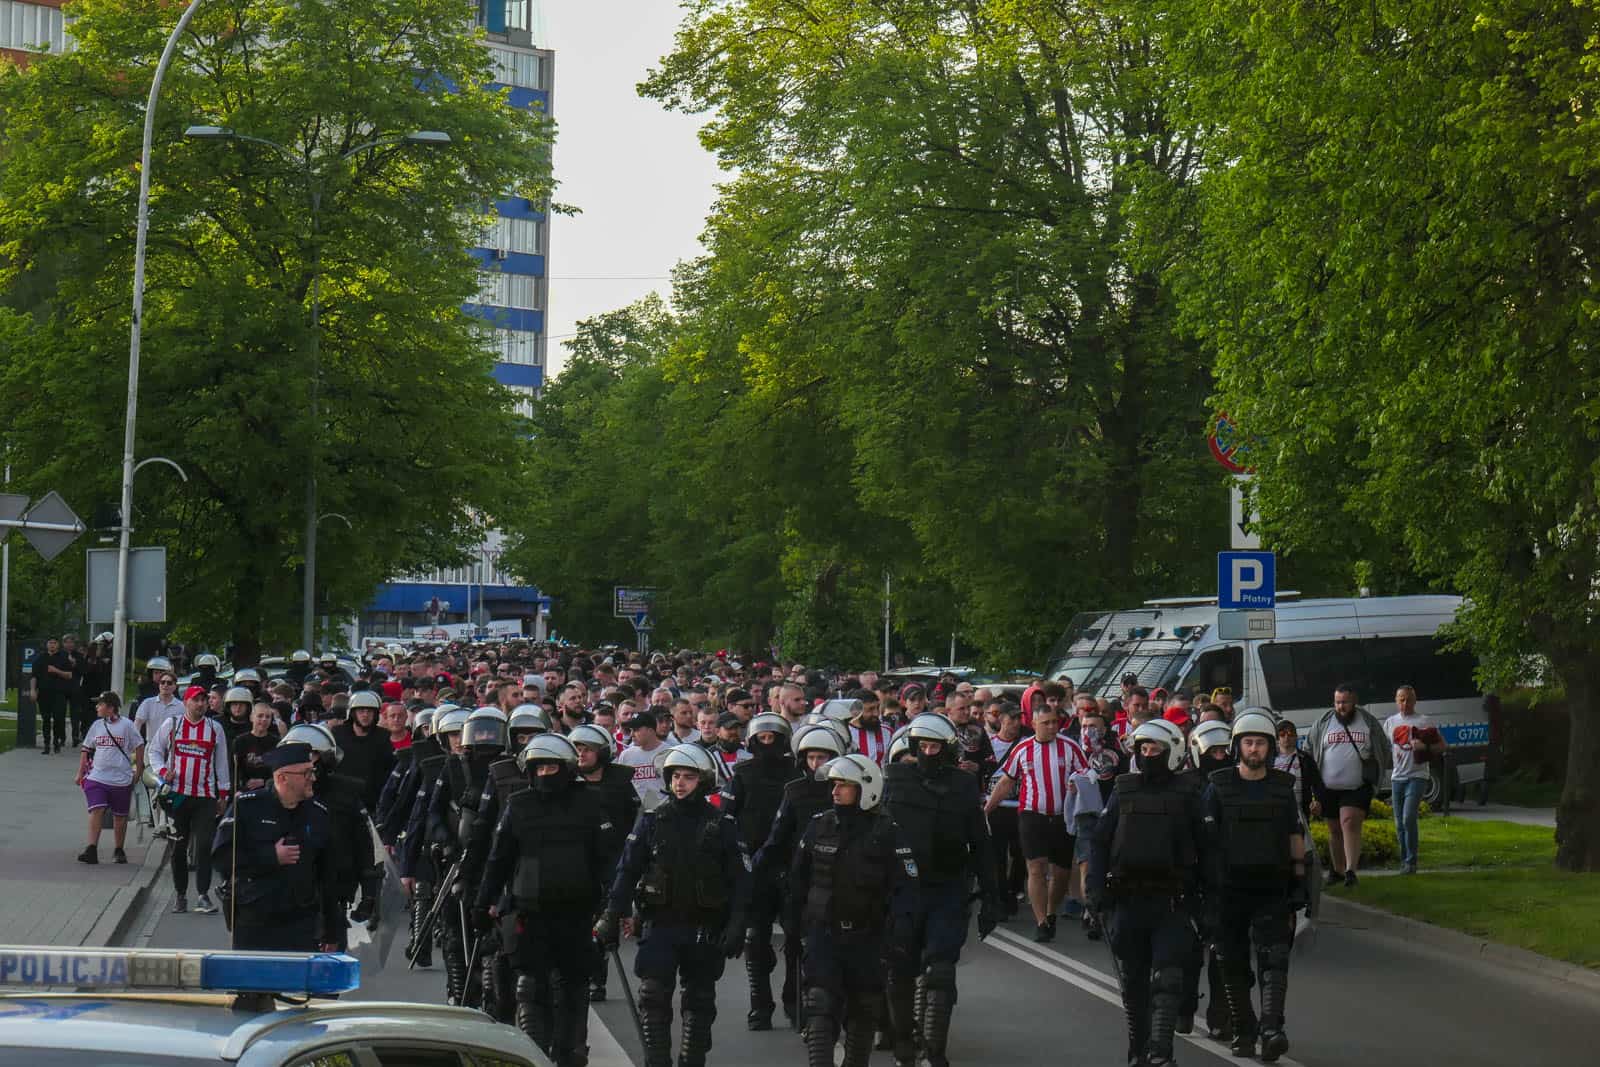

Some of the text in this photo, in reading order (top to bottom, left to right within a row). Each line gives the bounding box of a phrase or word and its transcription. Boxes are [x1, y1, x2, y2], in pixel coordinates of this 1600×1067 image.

[1231, 558, 1264, 602] P
[24, 647, 35, 660] P
[0, 954, 128, 984] POLICJA
